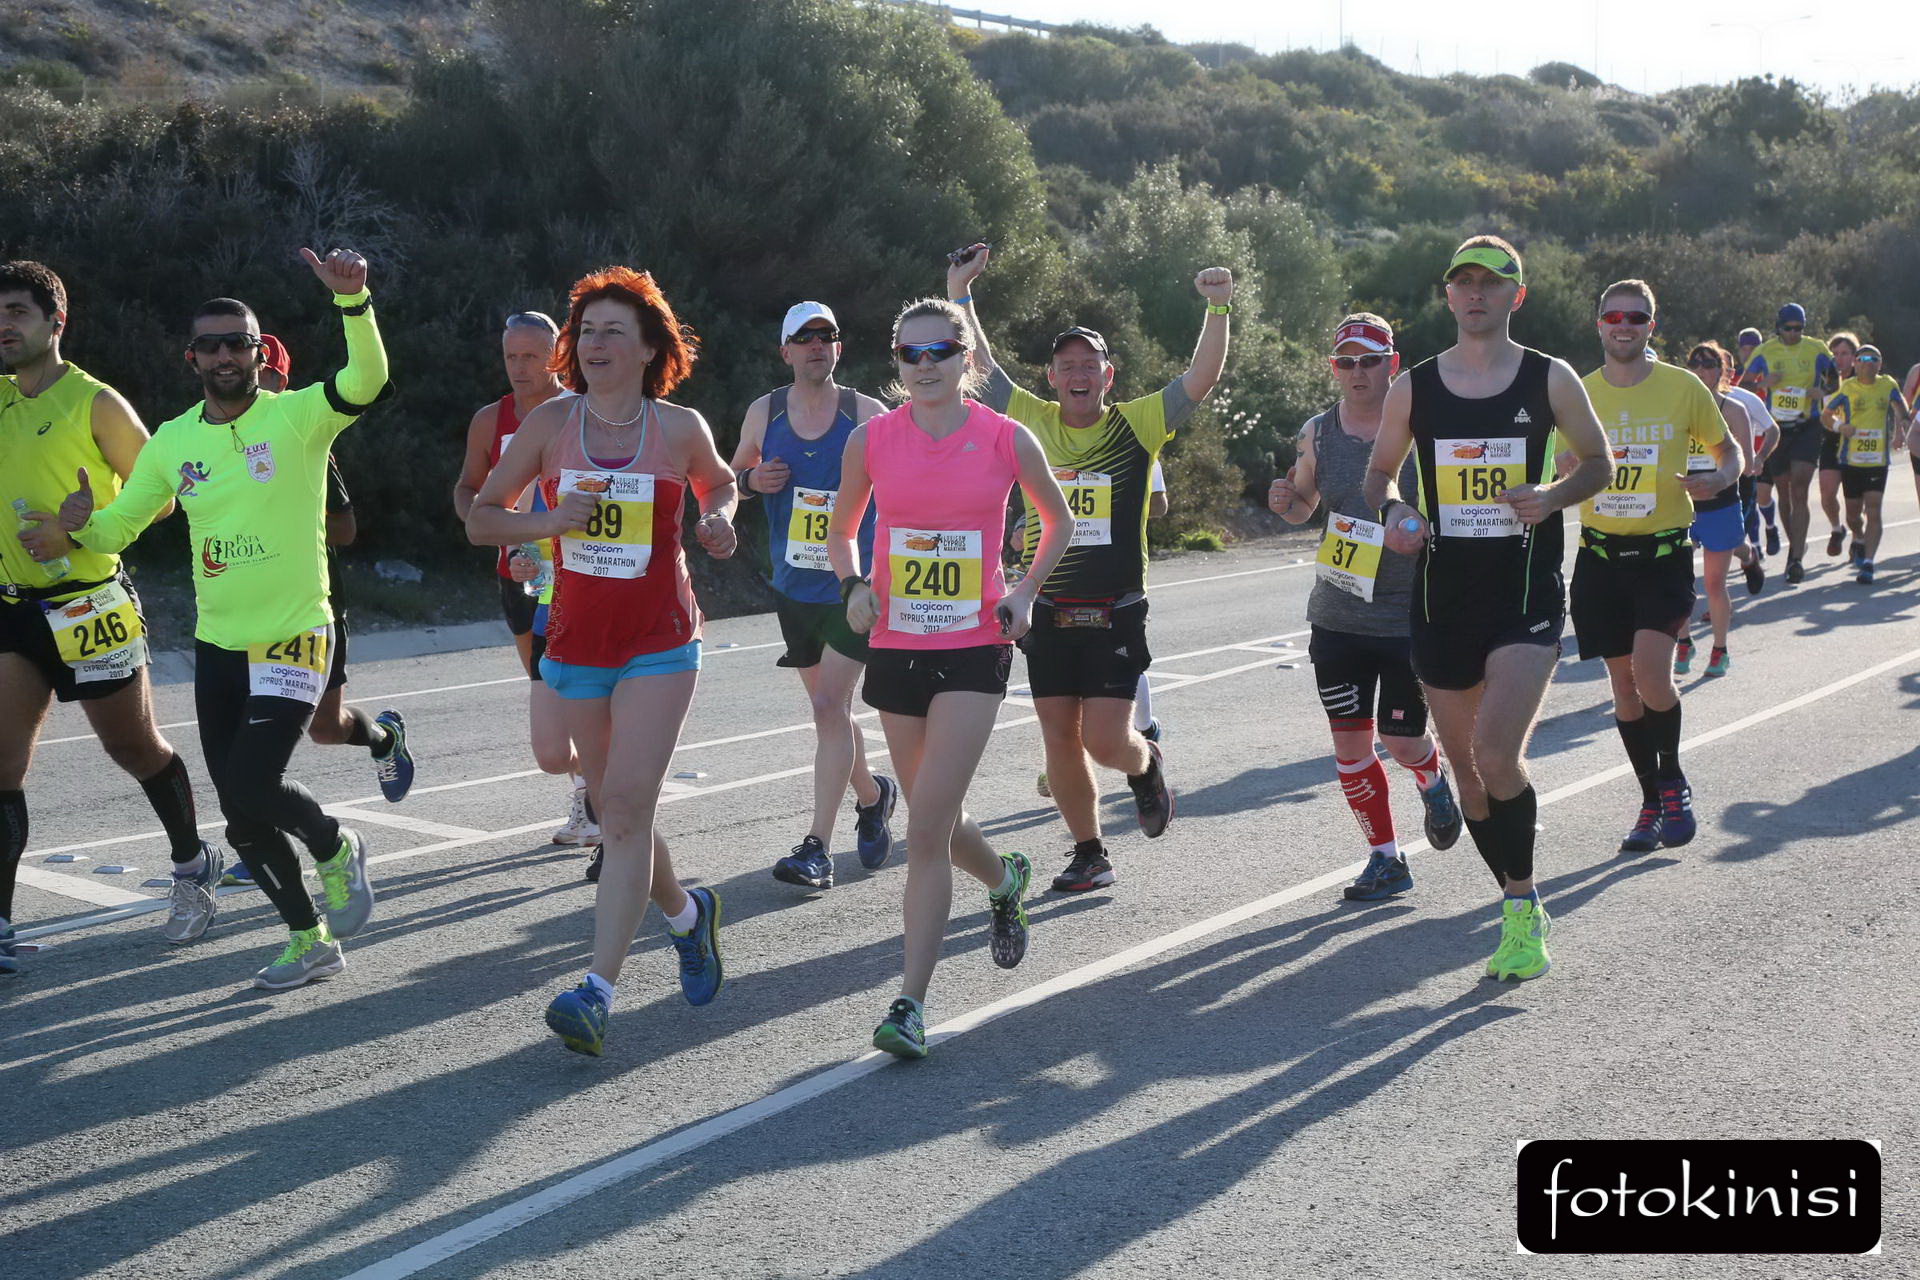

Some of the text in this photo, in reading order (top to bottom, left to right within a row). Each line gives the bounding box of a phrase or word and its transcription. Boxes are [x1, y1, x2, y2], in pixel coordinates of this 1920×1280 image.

[1777, 395, 1799, 409] 296
[1856, 439, 1878, 452] 299
[1457, 467, 1507, 501] 158
[1608, 465, 1643, 491] 07
[1460, 506, 1501, 518] Logicom
[585, 502, 623, 539] 89
[1450, 518, 1513, 527] CYPRUS MARATHON
[1473, 528, 1490, 537] 2017
[1070, 537, 1081, 545] 017
[582, 542, 624, 555] Logicom
[1332, 538, 1359, 569] 37
[571, 551, 637, 568] CYPRUS MARATHON
[592, 566, 609, 577] 2017
[904, 559, 961, 597] 240
[910, 601, 954, 614] Logicom
[900, 612, 926, 623] CYPRUS
[73, 611, 129, 658] 246
[923, 625, 940, 634] 2017
[265, 633, 317, 667] 241
[108, 669, 125, 679] 2017
[270, 665, 310, 679] Logicom
[259, 676, 317, 694] CYPRUS MARATHON
[280, 687, 297, 697] 2017
